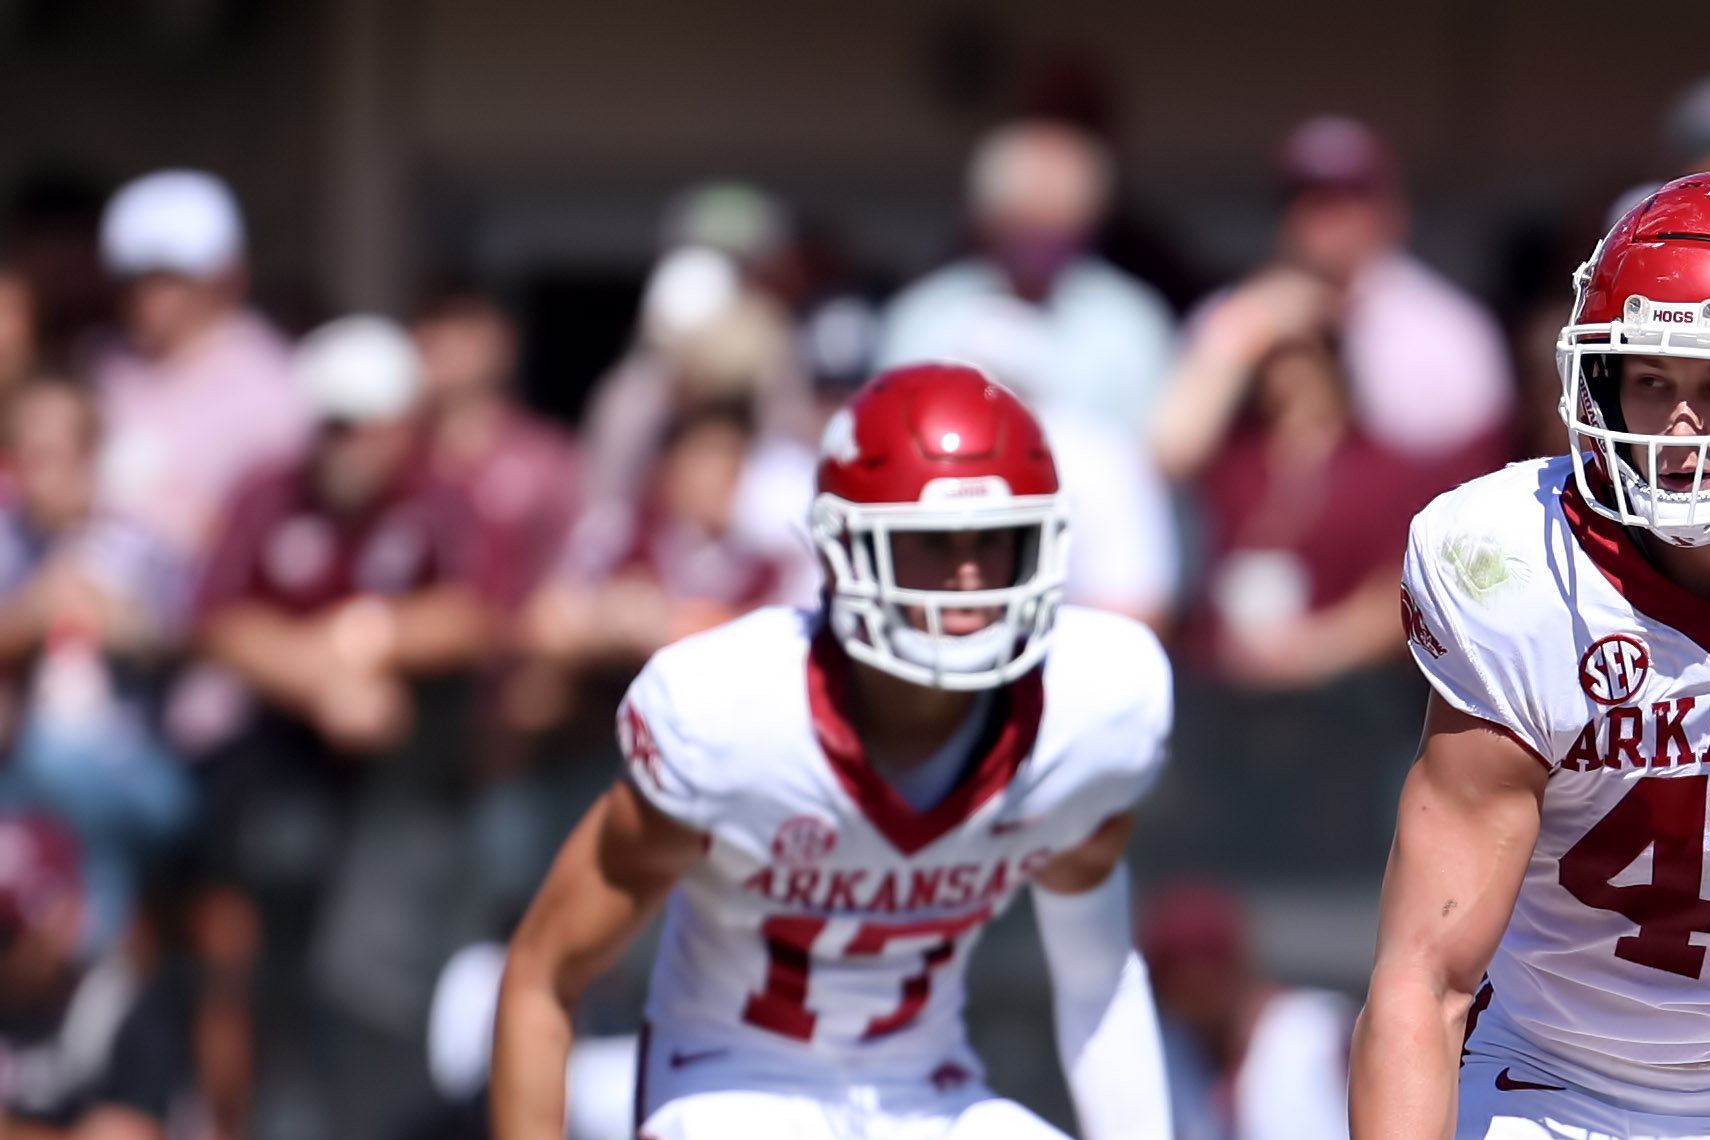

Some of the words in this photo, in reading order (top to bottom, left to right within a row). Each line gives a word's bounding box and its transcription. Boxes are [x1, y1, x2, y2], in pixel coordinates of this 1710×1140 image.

[1653, 309, 1694, 324] HOGS
[1583, 637, 1646, 702] SEC
[742, 848, 1053, 913] ARKANSAS
[742, 907, 993, 1042] 17
